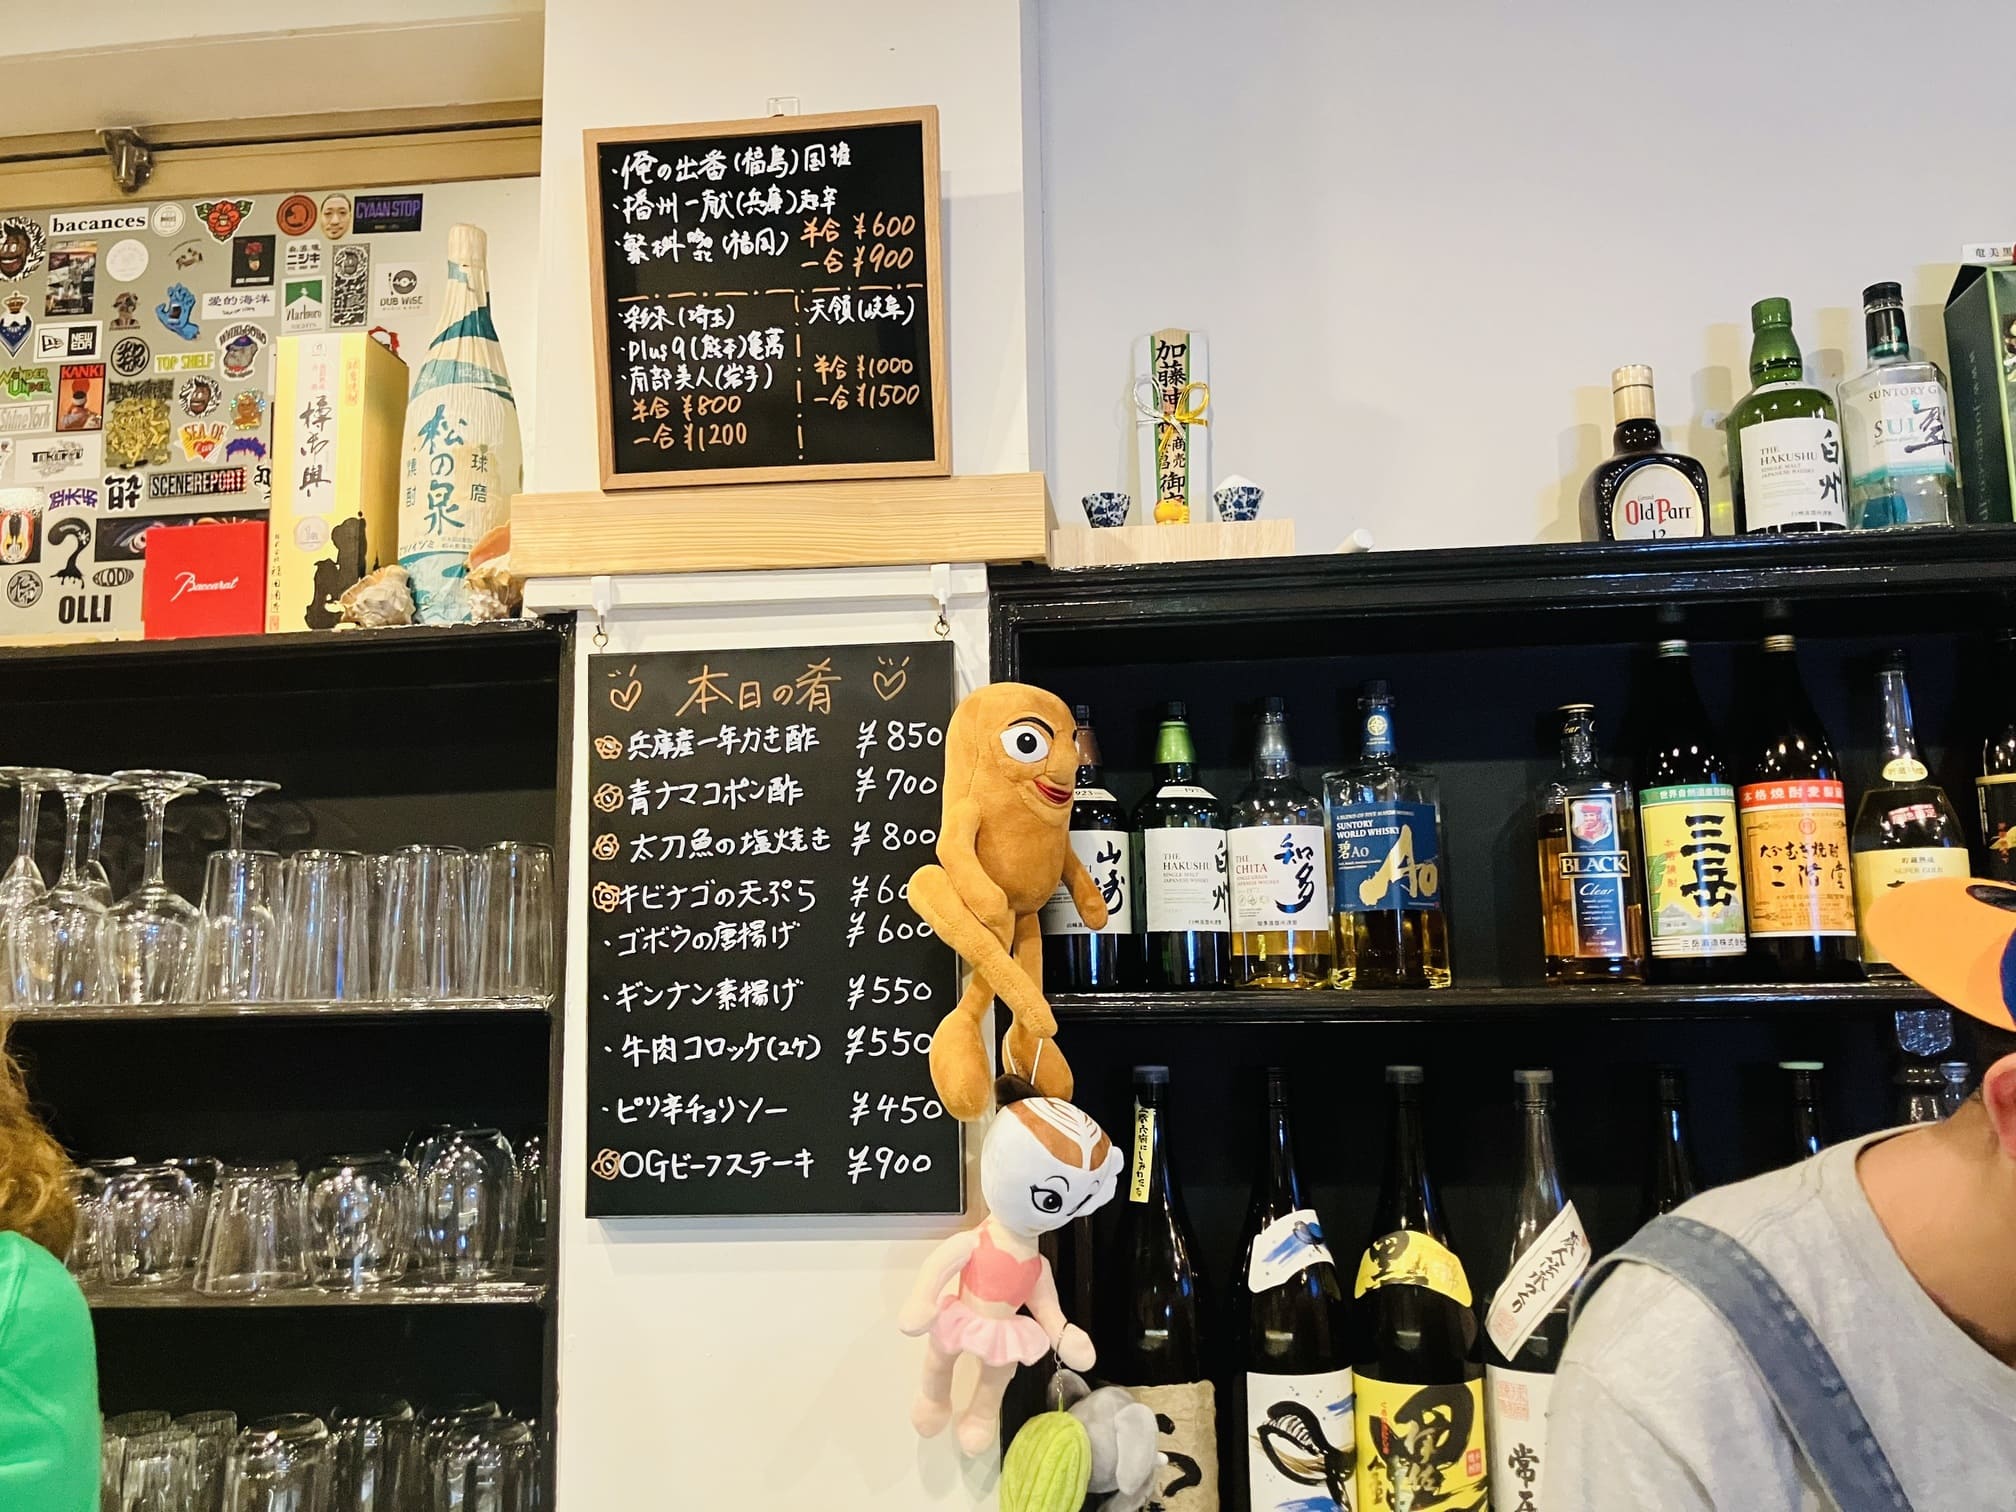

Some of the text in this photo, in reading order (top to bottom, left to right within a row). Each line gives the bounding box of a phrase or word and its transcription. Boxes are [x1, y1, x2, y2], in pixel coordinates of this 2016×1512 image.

[391, 199, 421, 217] STOP
[53, 214, 146, 233] bacances
[800, 211, 916, 248] 半合 ¥600
[801, 243, 914, 277] 一合 ¥900
[380, 296, 398, 307] DUB
[71, 332, 93, 343] NEW
[61, 364, 104, 378] KANKI
[157, 356, 179, 371] TOP
[181, 353, 214, 369] SHELF
[814, 354, 913, 385] 半合 ¥1000
[630, 363, 773, 396] 南部美人(岩手)
[1868, 386, 1925, 402] SUNTORY
[632, 394, 742, 422] 半合 ¥800
[814, 384, 920, 410] 一合 ¥1500
[184, 423, 227, 441] SEA OF
[634, 422, 747, 451] 一合 ¥1200
[1873, 417, 1917, 439] SUI
[1760, 446, 1779, 456] THE
[1760, 452, 1818, 466] HAKUSHU
[152, 474, 193, 497] SCENE
[194, 468, 245, 494] REPORT
[418, 404, 468, 536] 松の泉
[471, 453, 489, 504] 球磨
[1819, 429, 1845, 512] 白州
[1625, 498, 1692, 526] Old Parr
[170, 571, 239, 601] Baccarat
[58, 594, 112, 624] OLLI
[675, 657, 842, 717] 本日の肴
[856, 719, 943, 759] ¥850
[628, 765, 938, 816] 青ナマコポン酢 ¥700
[1336, 819, 1373, 831] SUNTORY
[1336, 826, 1400, 840] WORLD WHISKY
[630, 821, 938, 864] 太刀魚の塩焼き ¥800
[1163, 853, 1180, 861] THE
[1162, 861, 1211, 872] HAKUSHU
[1235, 863, 1268, 875] CHITA
[1236, 855, 1249, 863] THE
[1273, 832, 1315, 914] 知多
[1561, 854, 1628, 874] BLACK
[1680, 814, 1737, 908] 三岳
[619, 878, 816, 914] キビナゴの天ぷら
[1579, 883, 1615, 896] Clear
[618, 911, 935, 957] ゴボウの唐揚げ ¥600
[616, 974, 932, 1012] ギンナン素揚げ ¥550
[845, 1025, 933, 1065] ¥550
[617, 1091, 943, 1127] ピリ辛チョリソー ¥450
[620, 1145, 932, 1185] OGビーフステーキ ¥900
